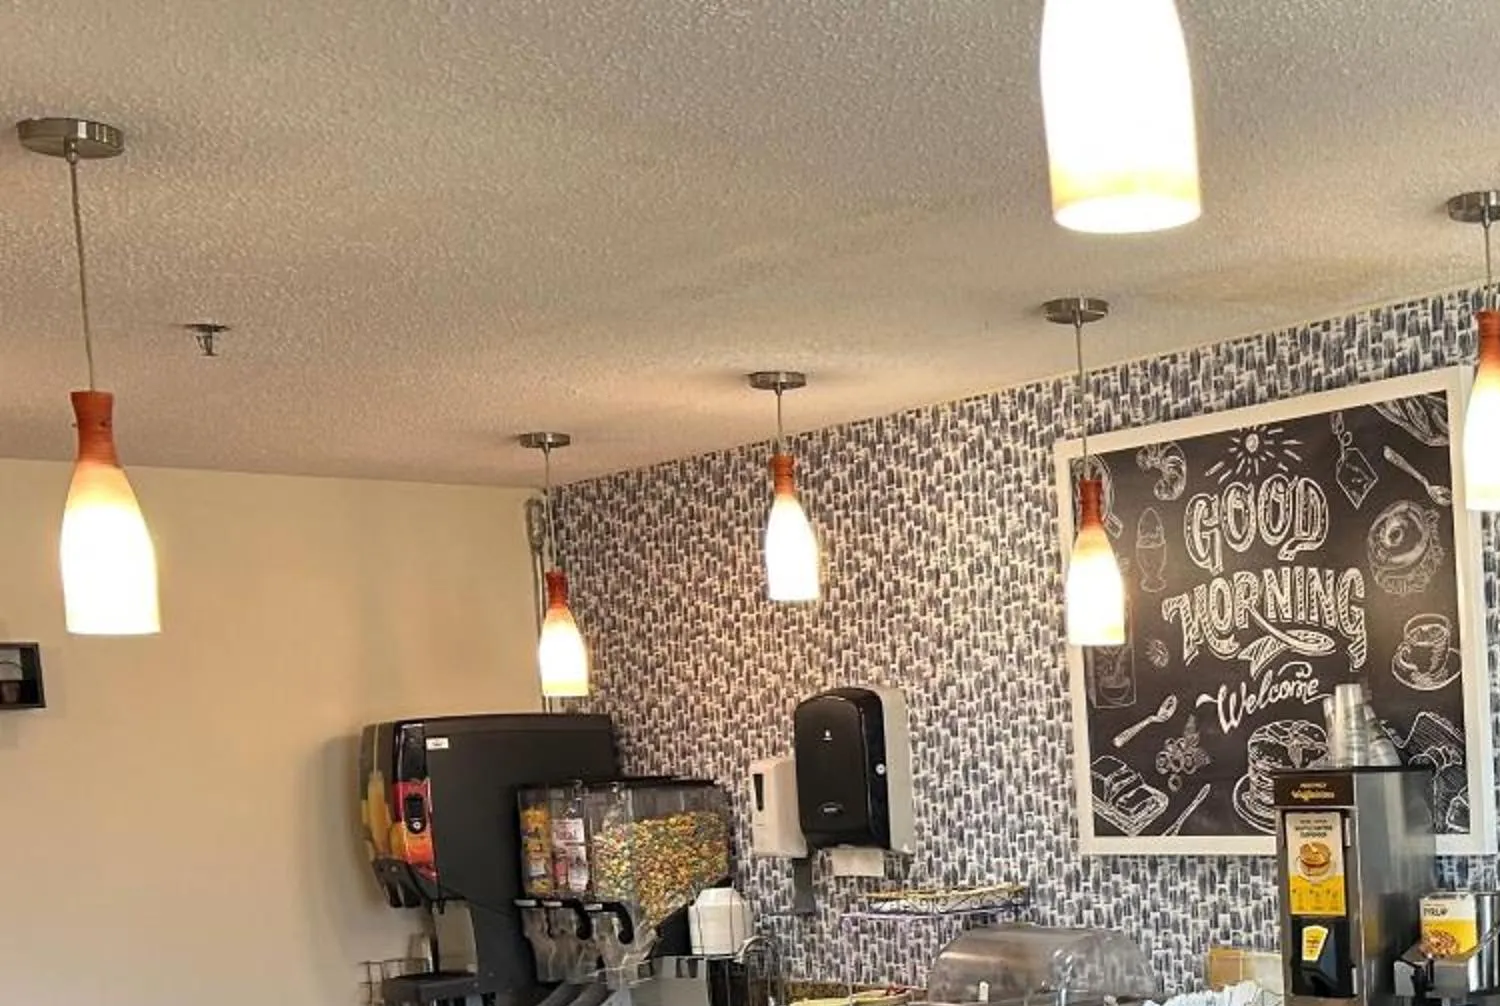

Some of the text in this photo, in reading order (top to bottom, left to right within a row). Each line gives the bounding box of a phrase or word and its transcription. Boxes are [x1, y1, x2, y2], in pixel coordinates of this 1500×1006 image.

[1183, 473, 1330, 576] GOOD
[1161, 566, 1368, 672] MORNING
[1196, 661, 1335, 735] Welcome
